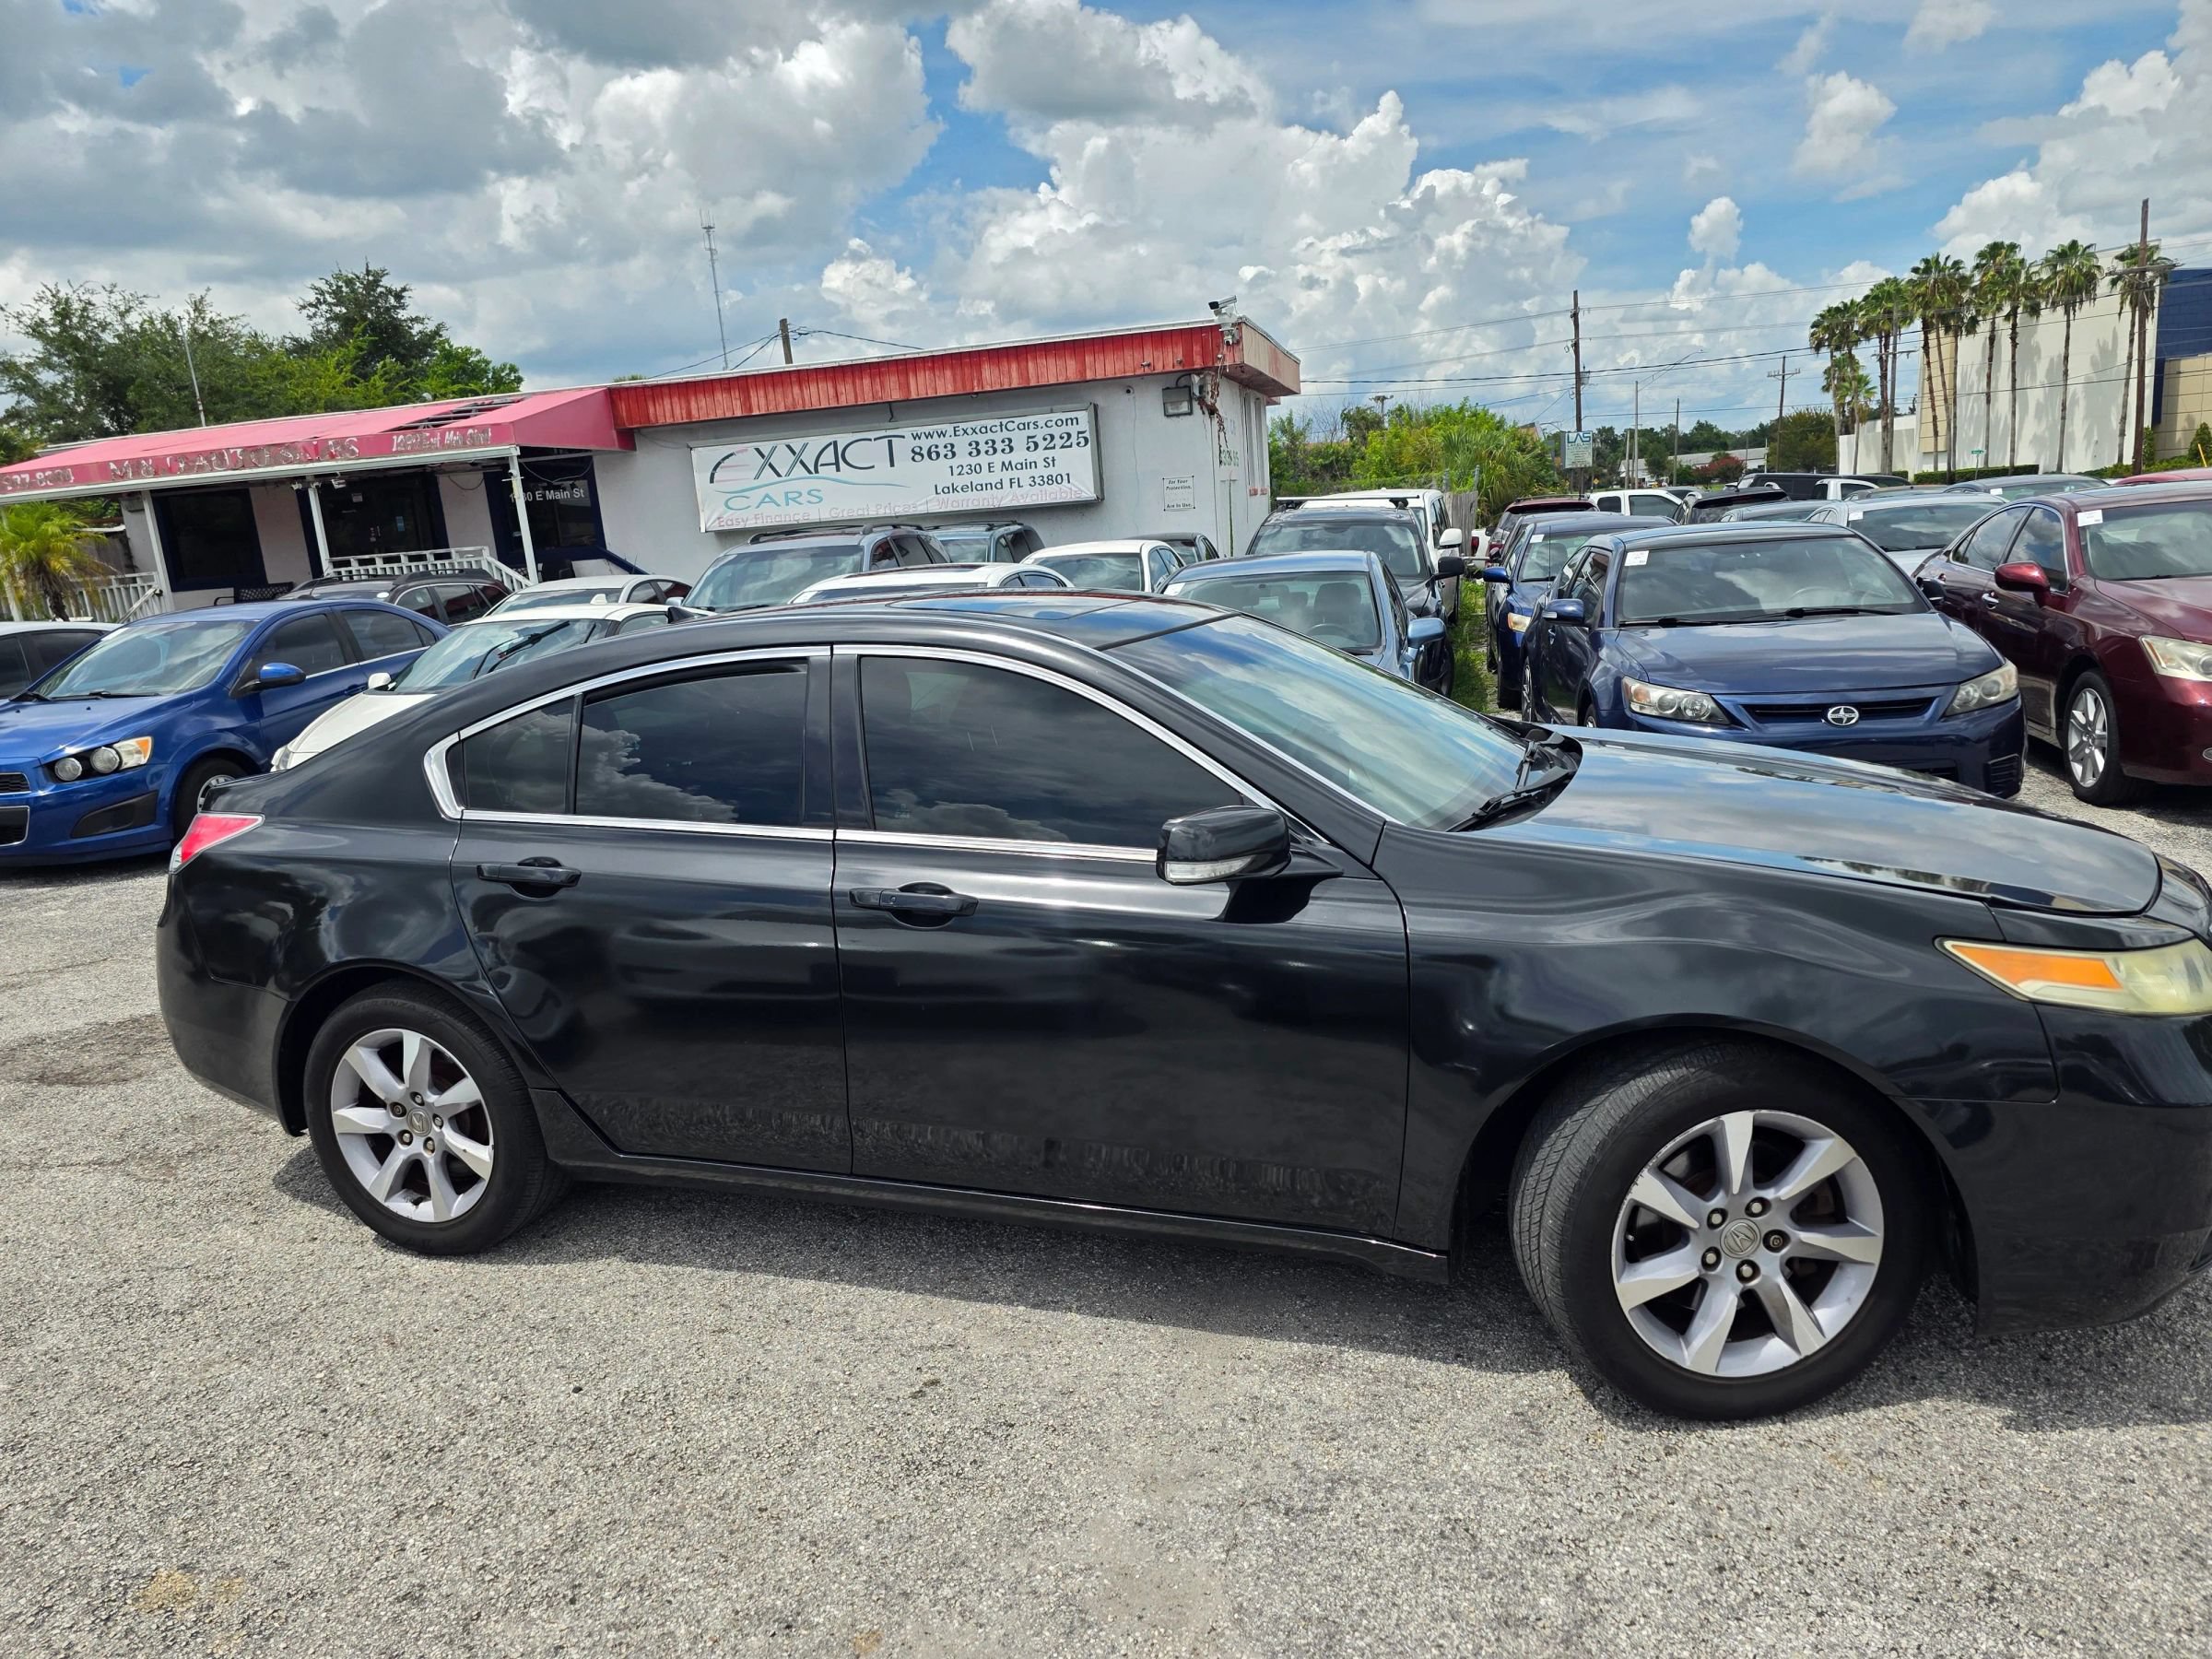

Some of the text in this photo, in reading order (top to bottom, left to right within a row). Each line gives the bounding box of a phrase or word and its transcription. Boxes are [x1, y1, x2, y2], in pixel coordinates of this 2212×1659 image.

[911, 417, 1079, 441] www.ExxactCars.com
[1568, 432, 1591, 443] LAS
[911, 429, 1089, 463] 863 333 5225
[710, 434, 906, 484] EXXACT
[948, 456, 1056, 477] 1230 E Main St
[535, 490, 544, 500] E
[546, 488, 571, 500] Main
[572, 488, 585, 499] St
[935, 473, 1071, 495] Lakeland FL 33801
[717, 514, 749, 528] Easy
[754, 510, 811, 524] Finance
[829, 503, 871, 518] Great
[937, 493, 1004, 510] Warranty
[1010, 486, 1084, 503] Available
[724, 488, 824, 512] CARS
